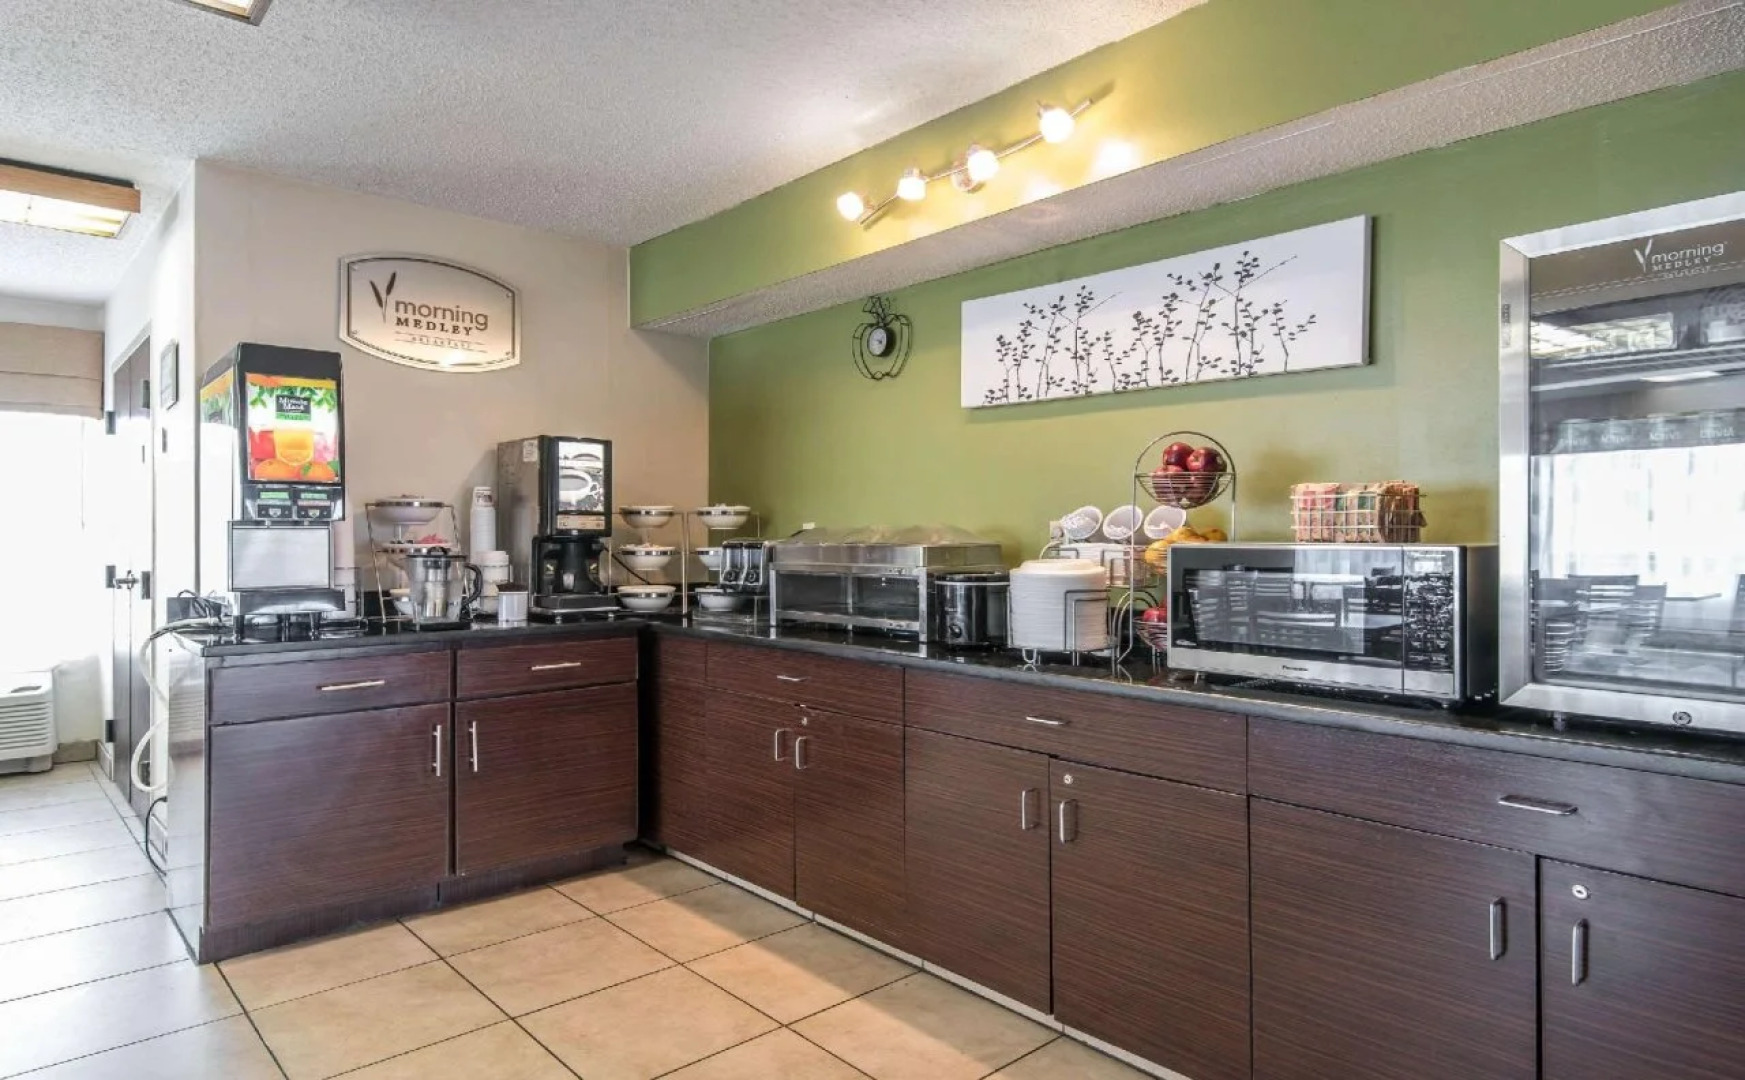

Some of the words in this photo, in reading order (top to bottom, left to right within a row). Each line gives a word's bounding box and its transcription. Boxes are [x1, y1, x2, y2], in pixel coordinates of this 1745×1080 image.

[1652, 244, 1724, 263] morning
[1653, 256, 1712, 270] MEDLEY
[395, 300, 488, 331] morning
[396, 317, 473, 336] MEDLEY
